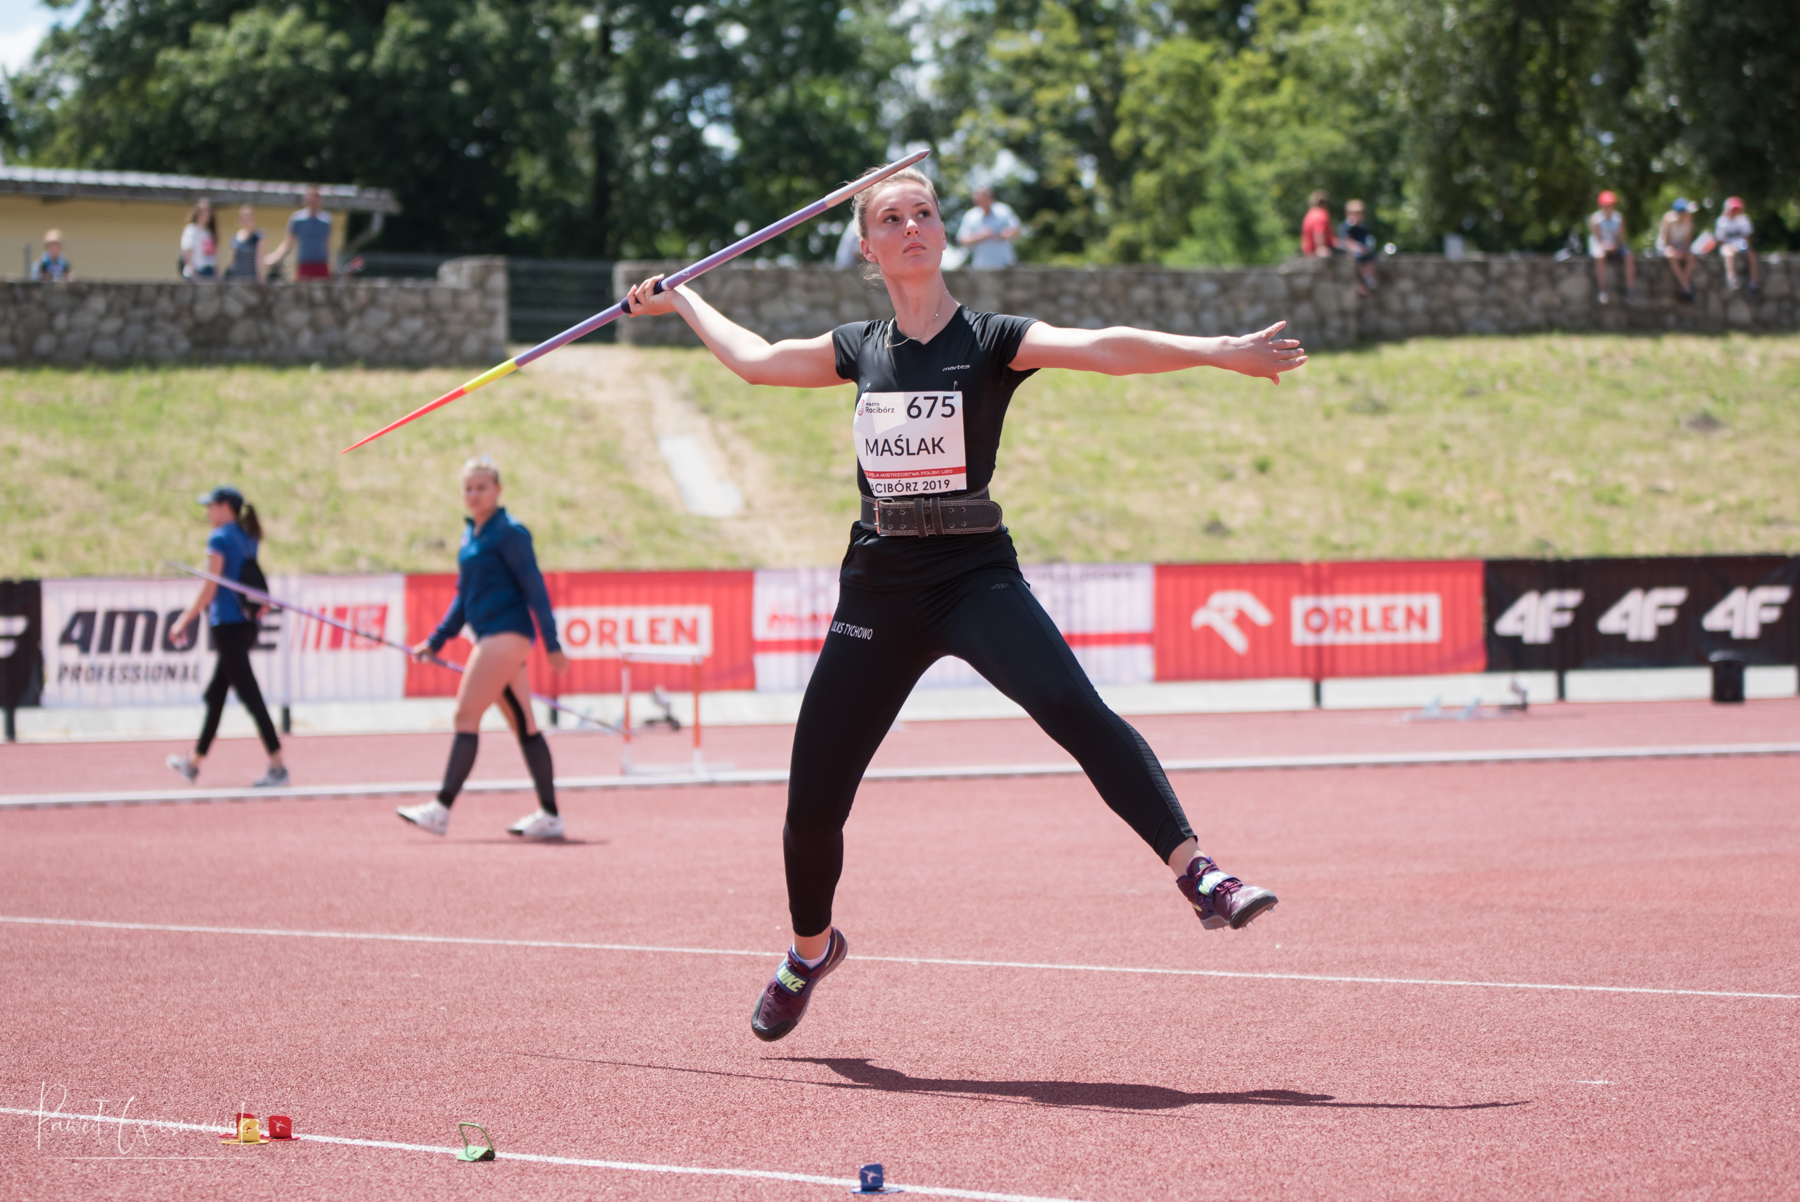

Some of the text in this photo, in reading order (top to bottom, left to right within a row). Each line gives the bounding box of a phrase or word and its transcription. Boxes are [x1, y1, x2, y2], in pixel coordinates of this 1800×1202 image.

[942, 364, 970, 372] martes
[906, 396, 956, 419] 675
[865, 434, 945, 456] MAŚLAK
[922, 479, 951, 491] 2019
[1302, 600, 1430, 634] ORLEN
[1494, 590, 1584, 644] 4F
[1597, 588, 1689, 642] 4F
[1702, 586, 1792, 640] 4F
[58, 608, 283, 654] 4MOE
[565, 616, 700, 649] ORLEN
[843, 623, 873, 640] TYCHOWO
